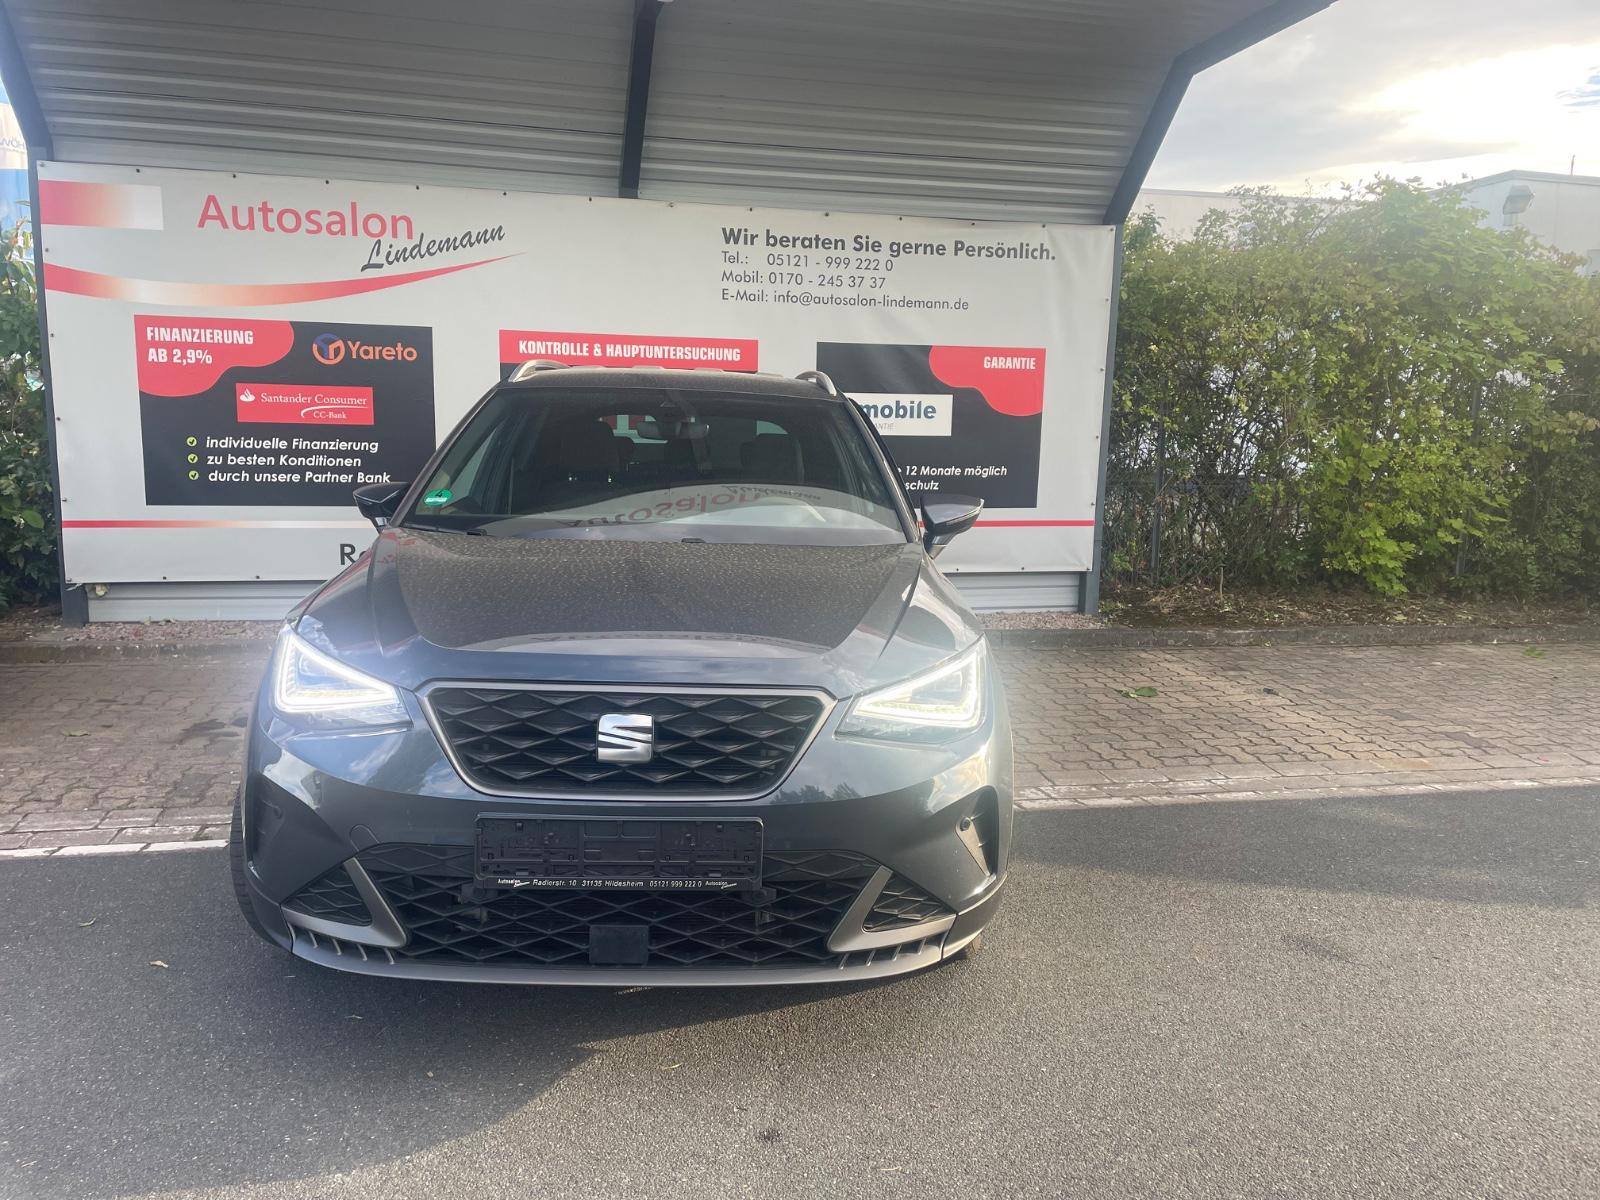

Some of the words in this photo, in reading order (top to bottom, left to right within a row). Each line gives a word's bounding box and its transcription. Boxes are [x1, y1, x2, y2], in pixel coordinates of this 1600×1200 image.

[197, 194, 413, 239] Autosalon
[360, 224, 505, 272] Lindemann
[721, 227, 758, 246] Wir
[765, 229, 846, 251] beraten
[852, 235, 882, 252] Sie
[889, 240, 946, 258] gerne
[953, 240, 1056, 261] Persönlich.
[722, 251, 749, 265] Tel.:
[767, 253, 809, 268] 05121
[825, 256, 850, 270] 999
[855, 257, 880, 271] 222
[885, 259, 894, 272] 0
[721, 270, 764, 284] Mobil:
[768, 271, 803, 286] 0170
[818, 275, 843, 288] 245
[848, 276, 864, 288] 37
[869, 276, 886, 289] 37
[721, 288, 769, 303] E-Mail:
[773, 290, 969, 311] info@autosalon-lindemann.de
[146, 327, 254, 344] FINANZIERUNG
[148, 348, 167, 363] AB
[172, 349, 213, 366] 2,9%
[347, 340, 417, 362] Yareto
[519, 340, 589, 356] KONTROLLE
[594, 343, 602, 357] &
[606, 343, 741, 361] HAUPTUNTERSUCHUNG
[983, 356, 1036, 370] GARANTIE
[261, 392, 311, 404] Santander
[314, 393, 367, 405] Consumer
[313, 410, 347, 419] CC-Bank
[206, 436, 288, 449] individuelle
[292, 438, 379, 453] Finanzierung
[206, 455, 223, 465] zu
[227, 454, 275, 466] besten
[279, 454, 362, 467] Konditionen
[208, 470, 249, 482] durch
[254, 473, 300, 483] unsere
[305, 471, 352, 483] Partner
[357, 471, 391, 483] Bank
[905, 466, 918, 476] 12
[920, 466, 961, 476] Monate
[964, 465, 1008, 478] möglich
[569, 879, 577, 887] 10
[581, 879, 603, 887] 31135
